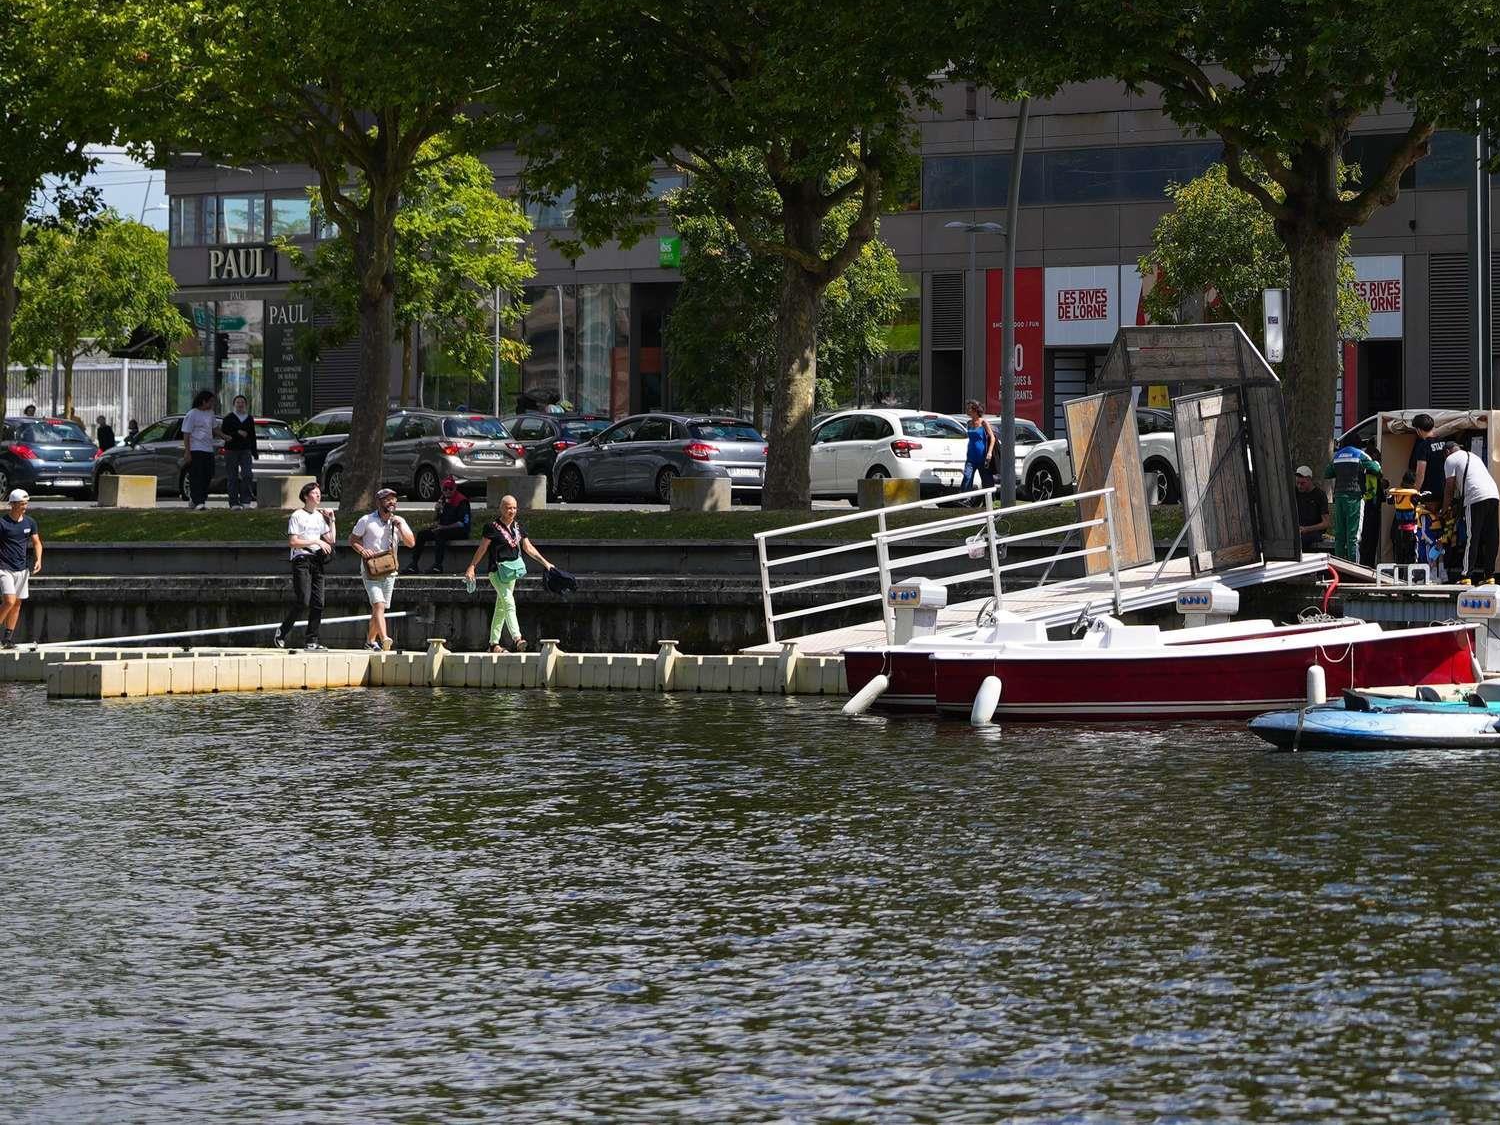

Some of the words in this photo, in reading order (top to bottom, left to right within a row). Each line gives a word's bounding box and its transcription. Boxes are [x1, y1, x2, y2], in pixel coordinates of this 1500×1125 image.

[209, 247, 271, 280] PAUL
[1370, 280, 1401, 296] RIVES
[1058, 291, 1076, 306] LES
[1079, 290, 1107, 305] RIVES
[269, 303, 309, 325] PAUL
[1058, 305, 1071, 320] DE
[1073, 304, 1107, 319] L'ORNE
